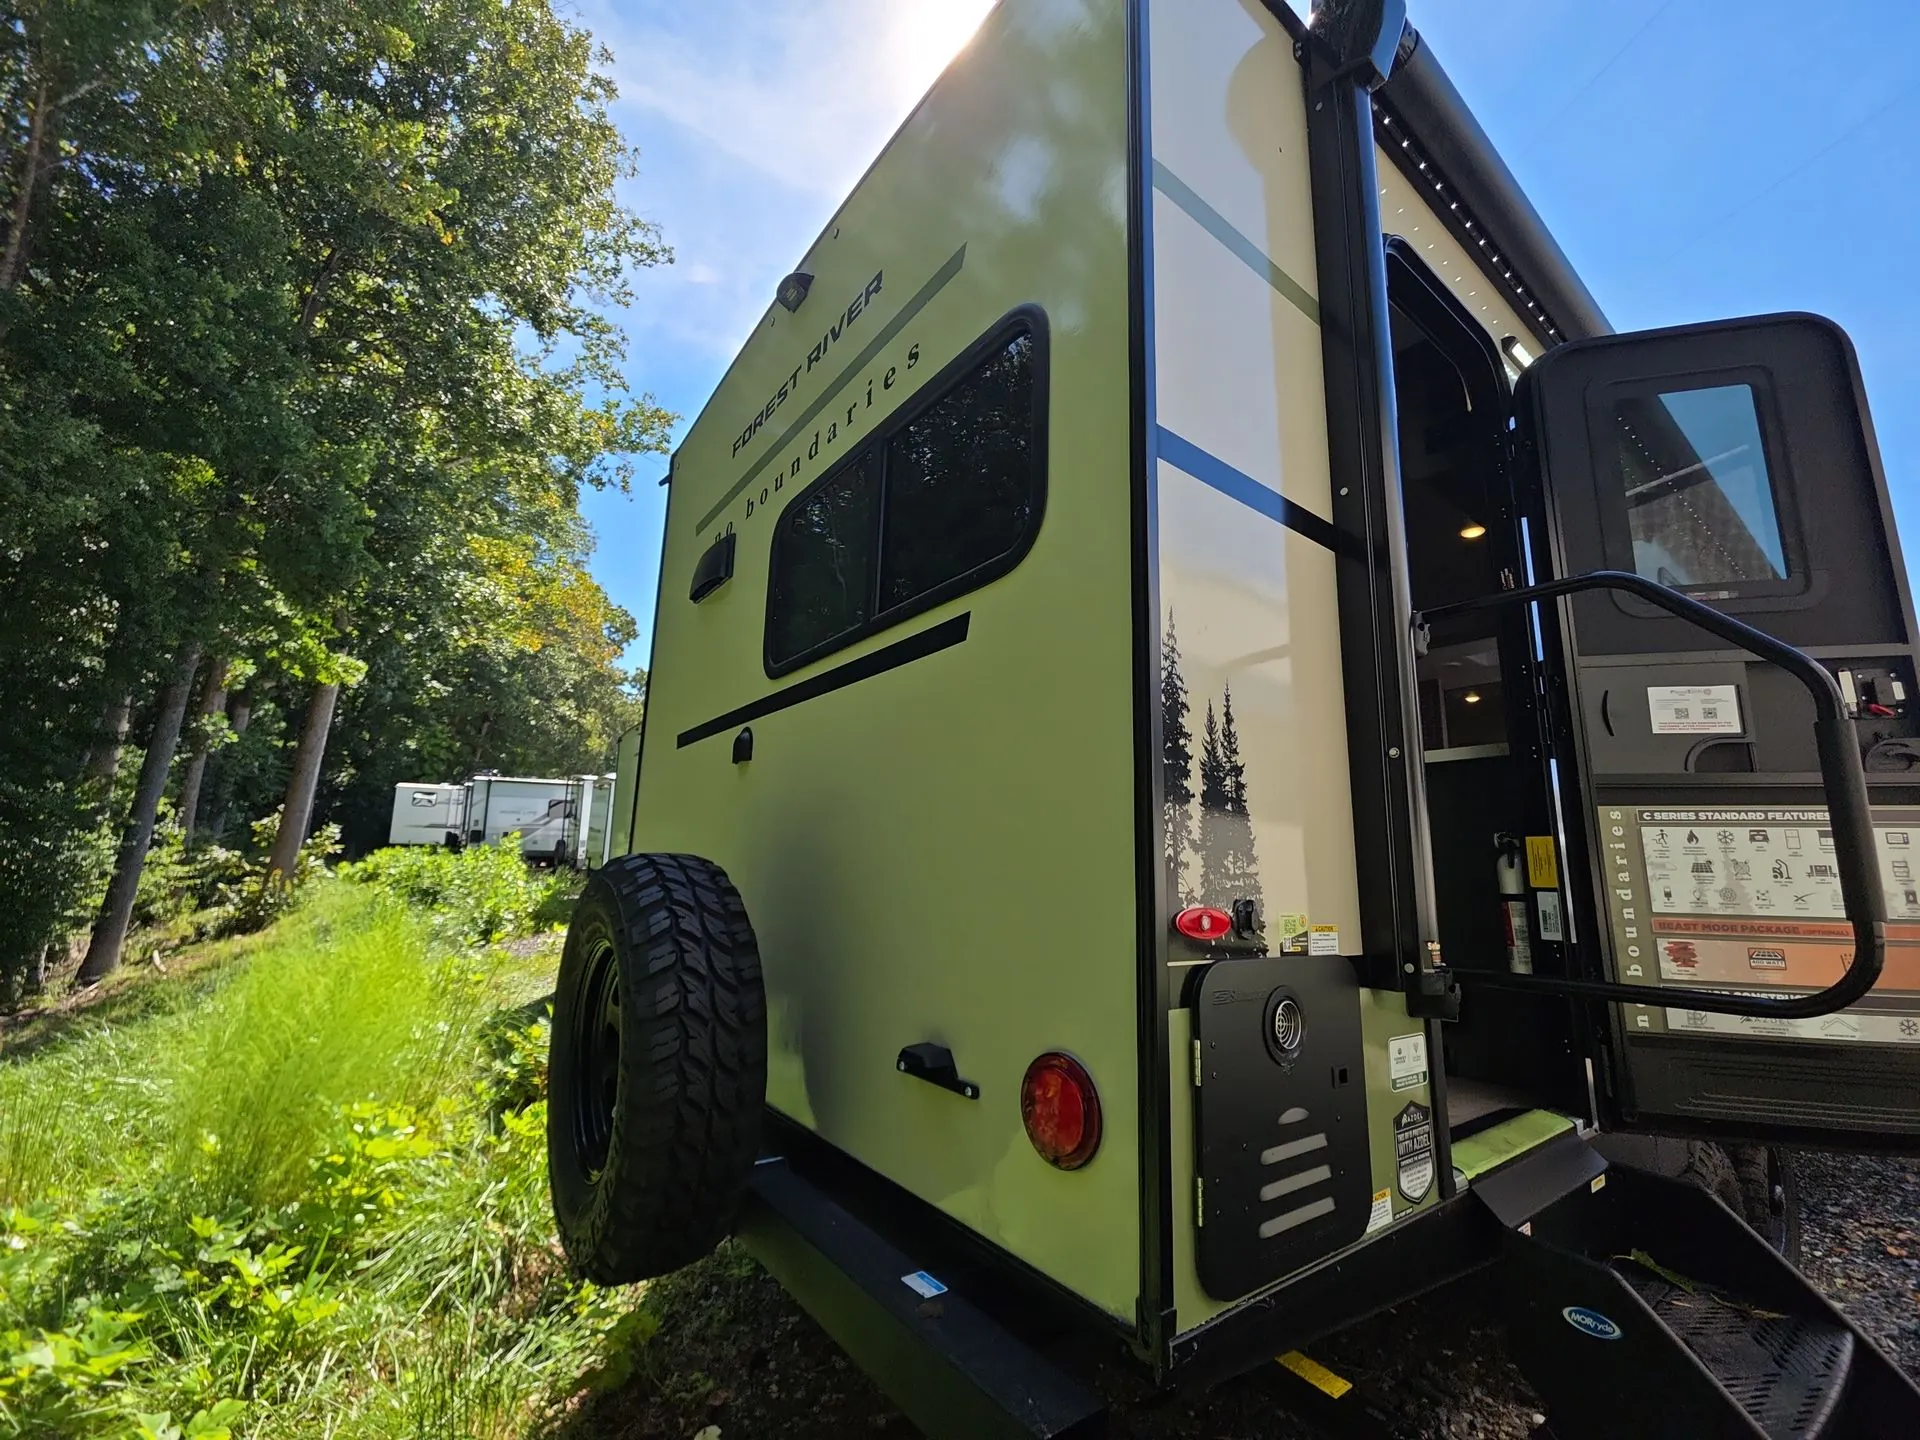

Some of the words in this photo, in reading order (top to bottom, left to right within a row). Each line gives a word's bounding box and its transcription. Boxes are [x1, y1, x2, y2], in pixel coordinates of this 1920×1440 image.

[732, 365, 802, 459] FOREST
[806, 269, 883, 374] RIVER
[745, 342, 920, 520] boundaries
[1643, 812, 1652, 820] C
[1653, 812, 1696, 820] SERIES
[1698, 812, 1765, 820] STANDARD
[1767, 812, 1830, 820] FEATURES
[1610, 810, 1643, 977] boundaries
[1658, 922, 1698, 931] BEAST
[1740, 924, 1801, 935] PACKAGE
[1414, 1134, 1430, 1151] AZDEL
[1571, 1312, 1613, 1333] MORryde
